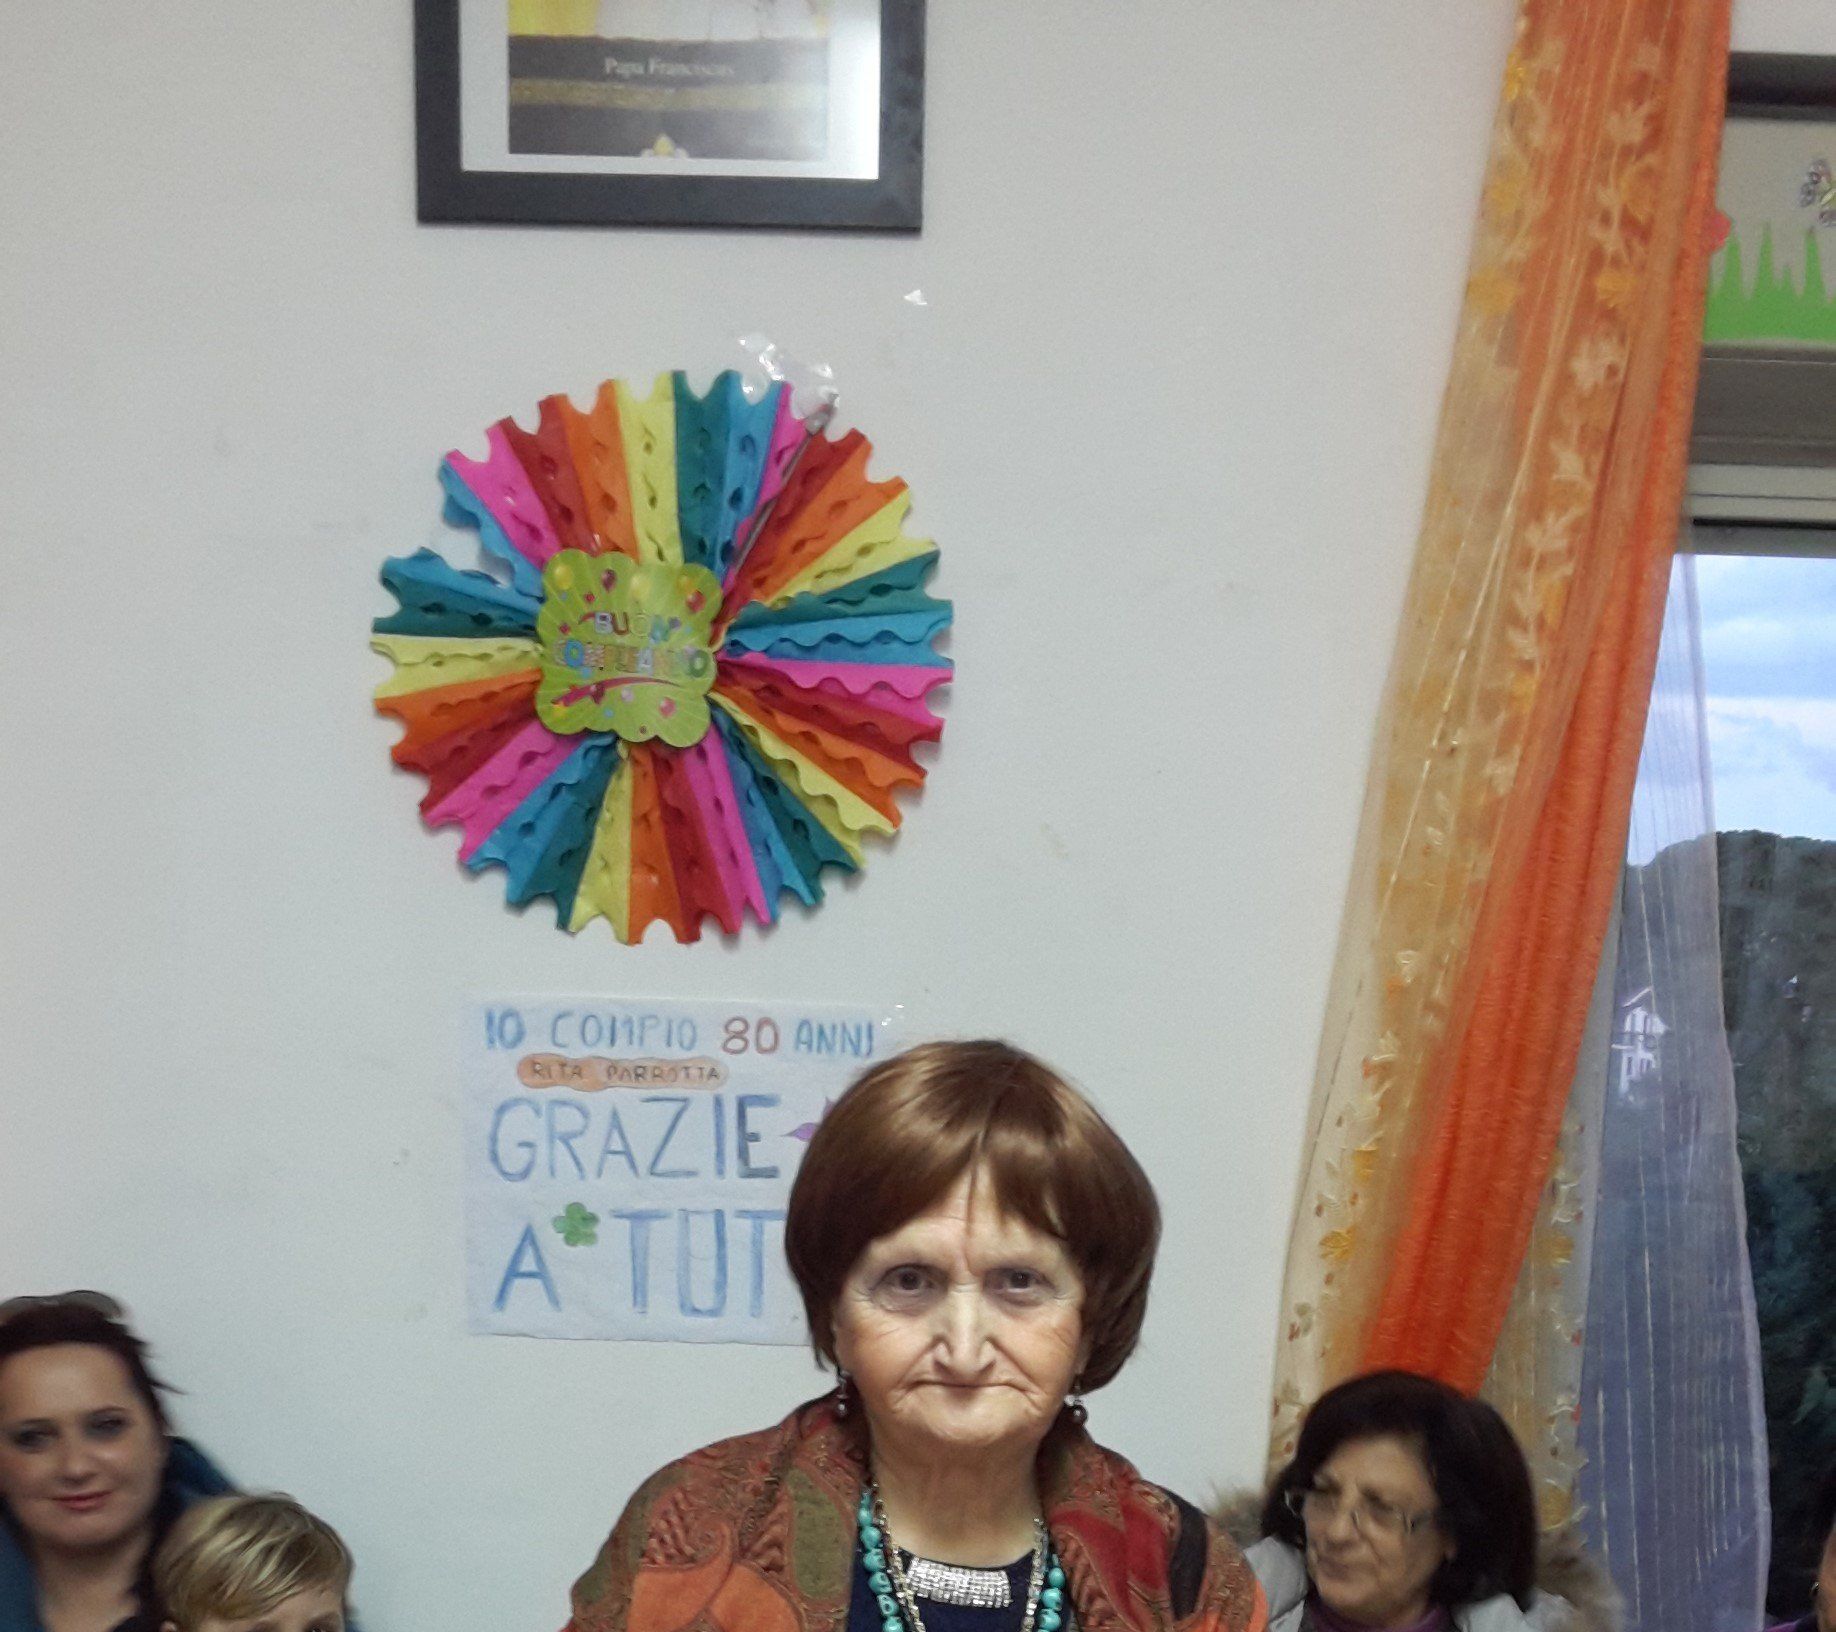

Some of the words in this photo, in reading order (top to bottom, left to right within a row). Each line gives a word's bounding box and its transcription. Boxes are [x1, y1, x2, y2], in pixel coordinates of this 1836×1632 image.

[551, 1010, 698, 1052] COMPIO
[720, 1015, 779, 1056] 80
[793, 1021, 874, 1057] ANNI
[532, 1060, 584, 1080] RITA
[606, 1065, 721, 1082] PARROTTA
[488, 1094, 782, 1183] GRAZIE
[493, 1223, 561, 1312] A
[610, 1209, 789, 1318] TUT
